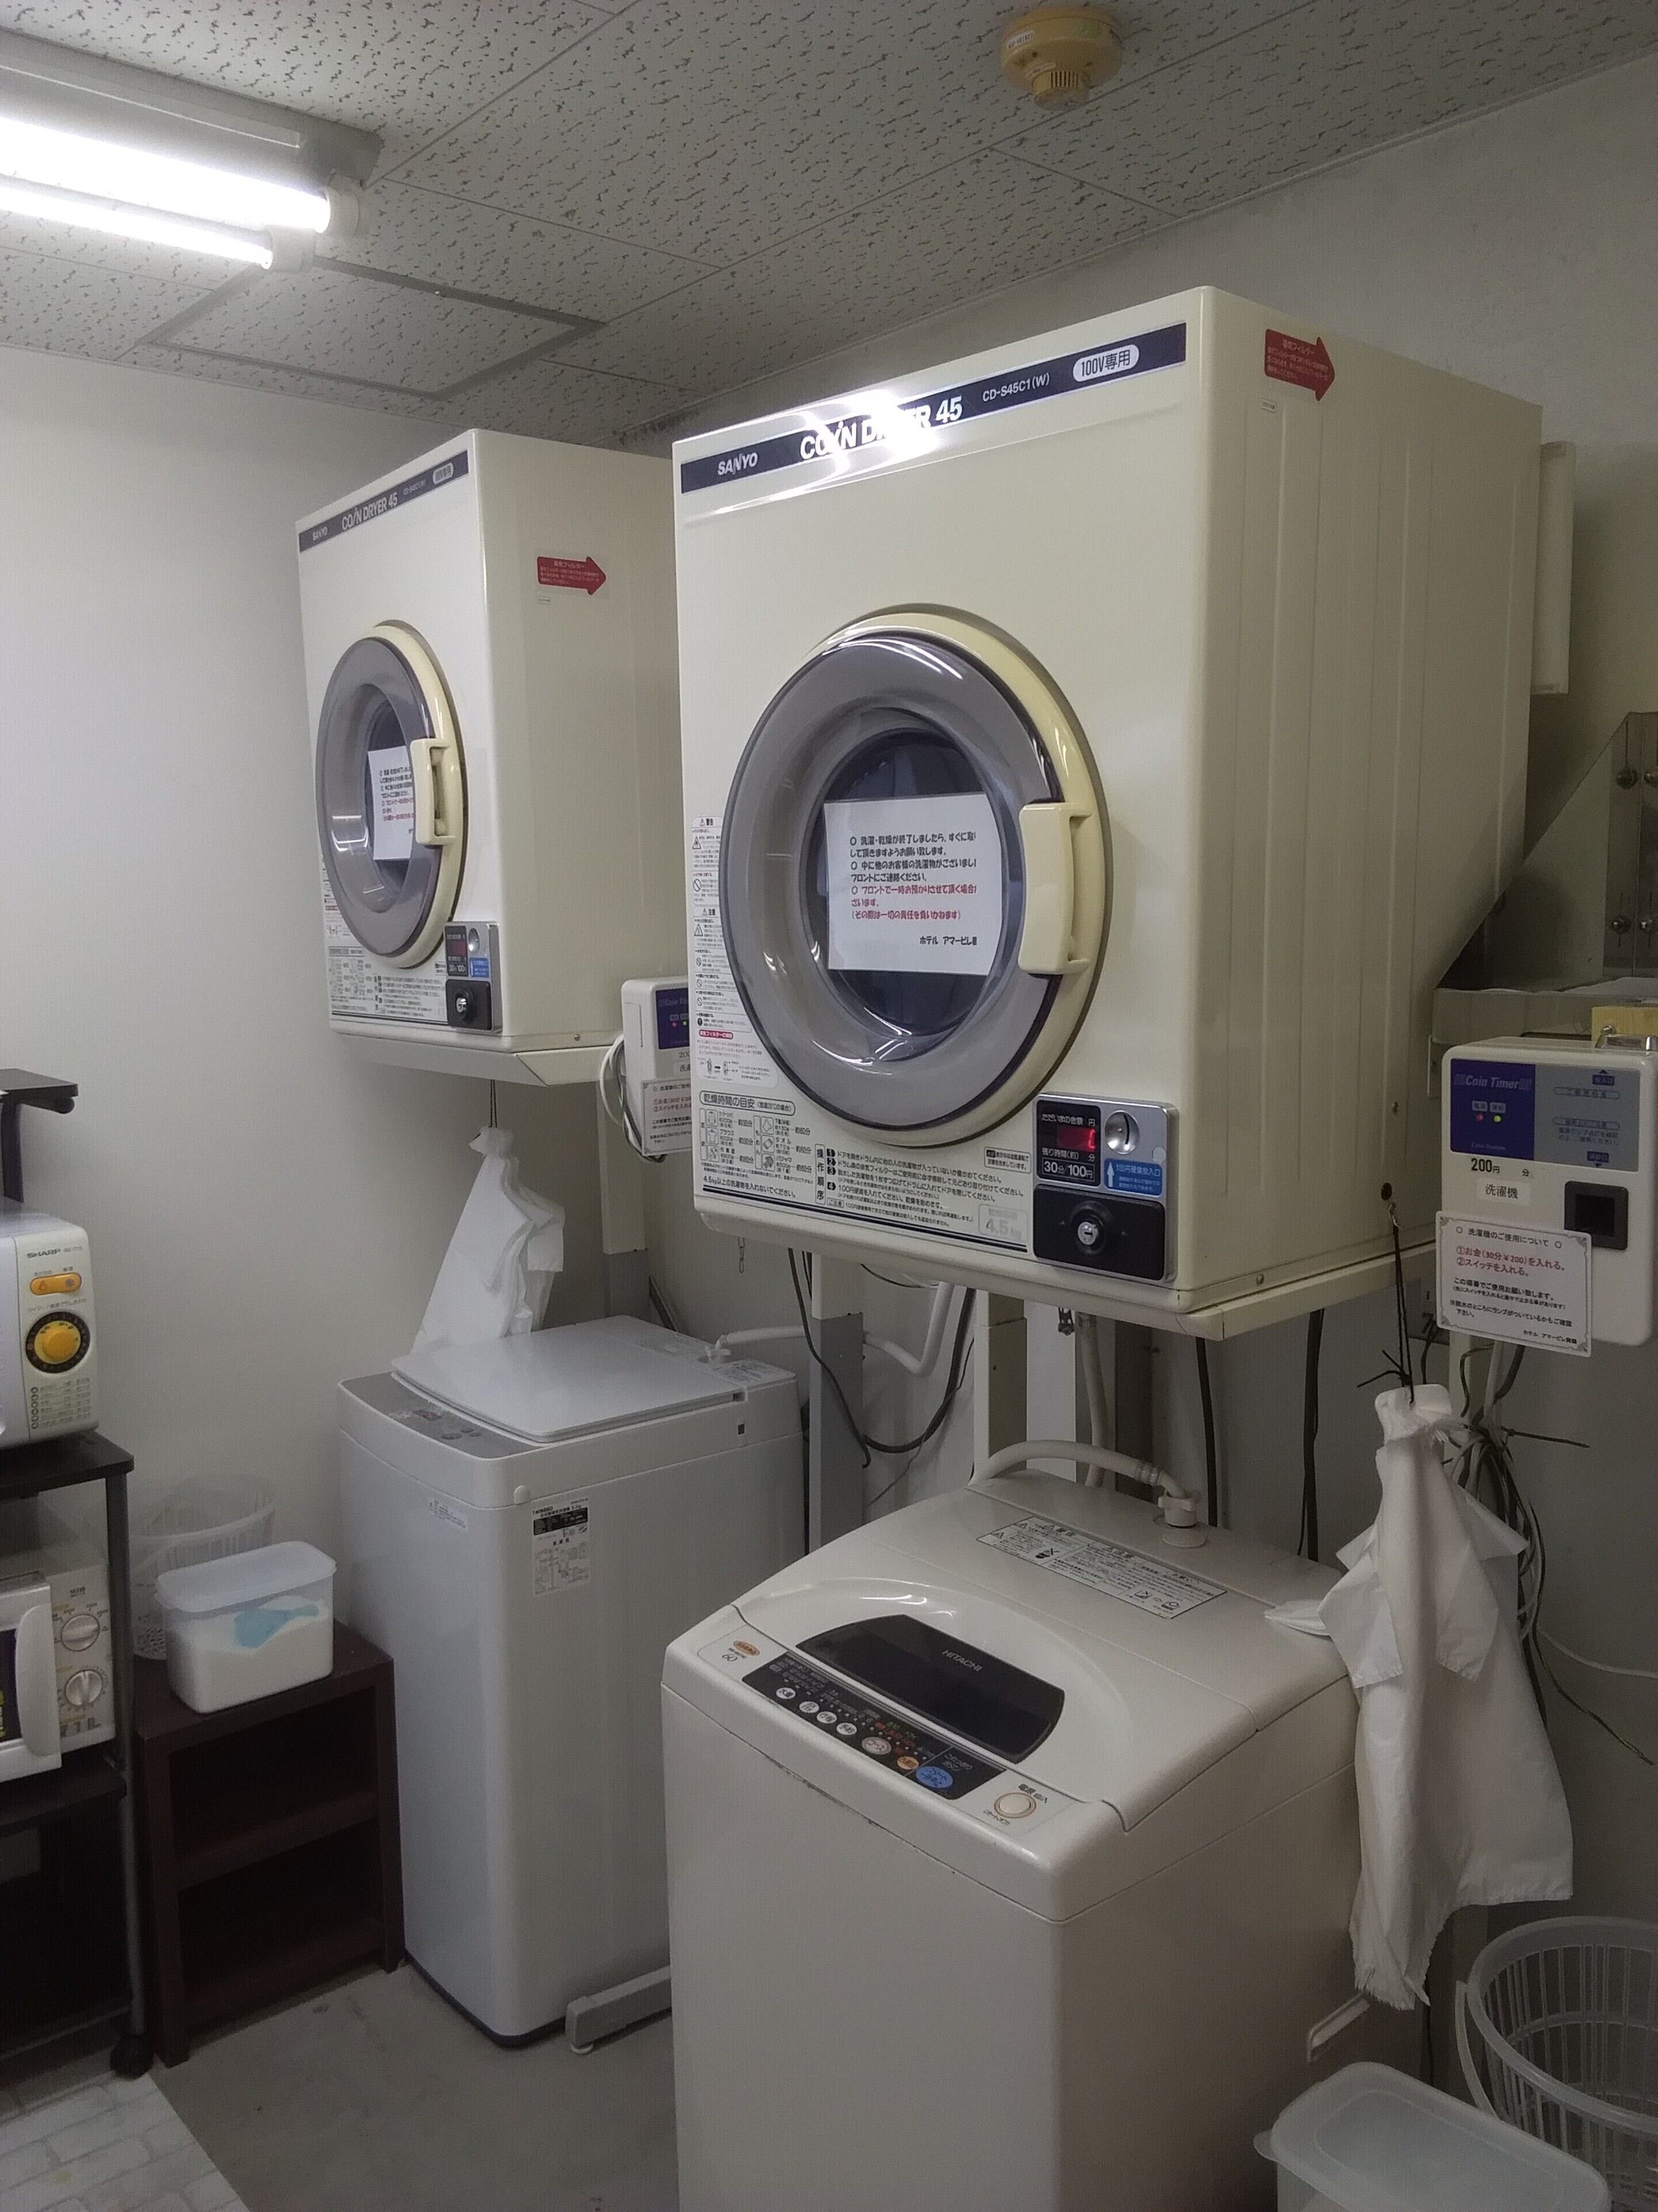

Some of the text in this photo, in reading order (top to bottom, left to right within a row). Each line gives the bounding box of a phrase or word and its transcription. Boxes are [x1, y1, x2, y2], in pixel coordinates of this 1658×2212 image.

[718, 453, 758, 475] SANYO
[936, 396, 963, 425] 45
[982, 372, 1050, 403] CD-S45C1(W)
[1080, 349, 1131, 378] 100V専用
[312, 527, 328, 540] SANYO
[363, 498, 387, 520] DRYER
[388, 492, 398, 507] 45
[920, 935, 938, 945] ホテル
[1466, 1075, 1520, 1090] Coin Timer
[1088, 1118, 1095, 1126] 円
[1088, 1153, 1095, 1162] 分
[1471, 1158, 1530, 1177] 200円 分
[1485, 1184, 1519, 1199] 洗濯機
[1468, 1228, 1549, 1247] 洗濯機のご使用について
[26, 1248, 62, 1260] SHARP
[942, 1649, 983, 1672] HITACHI
